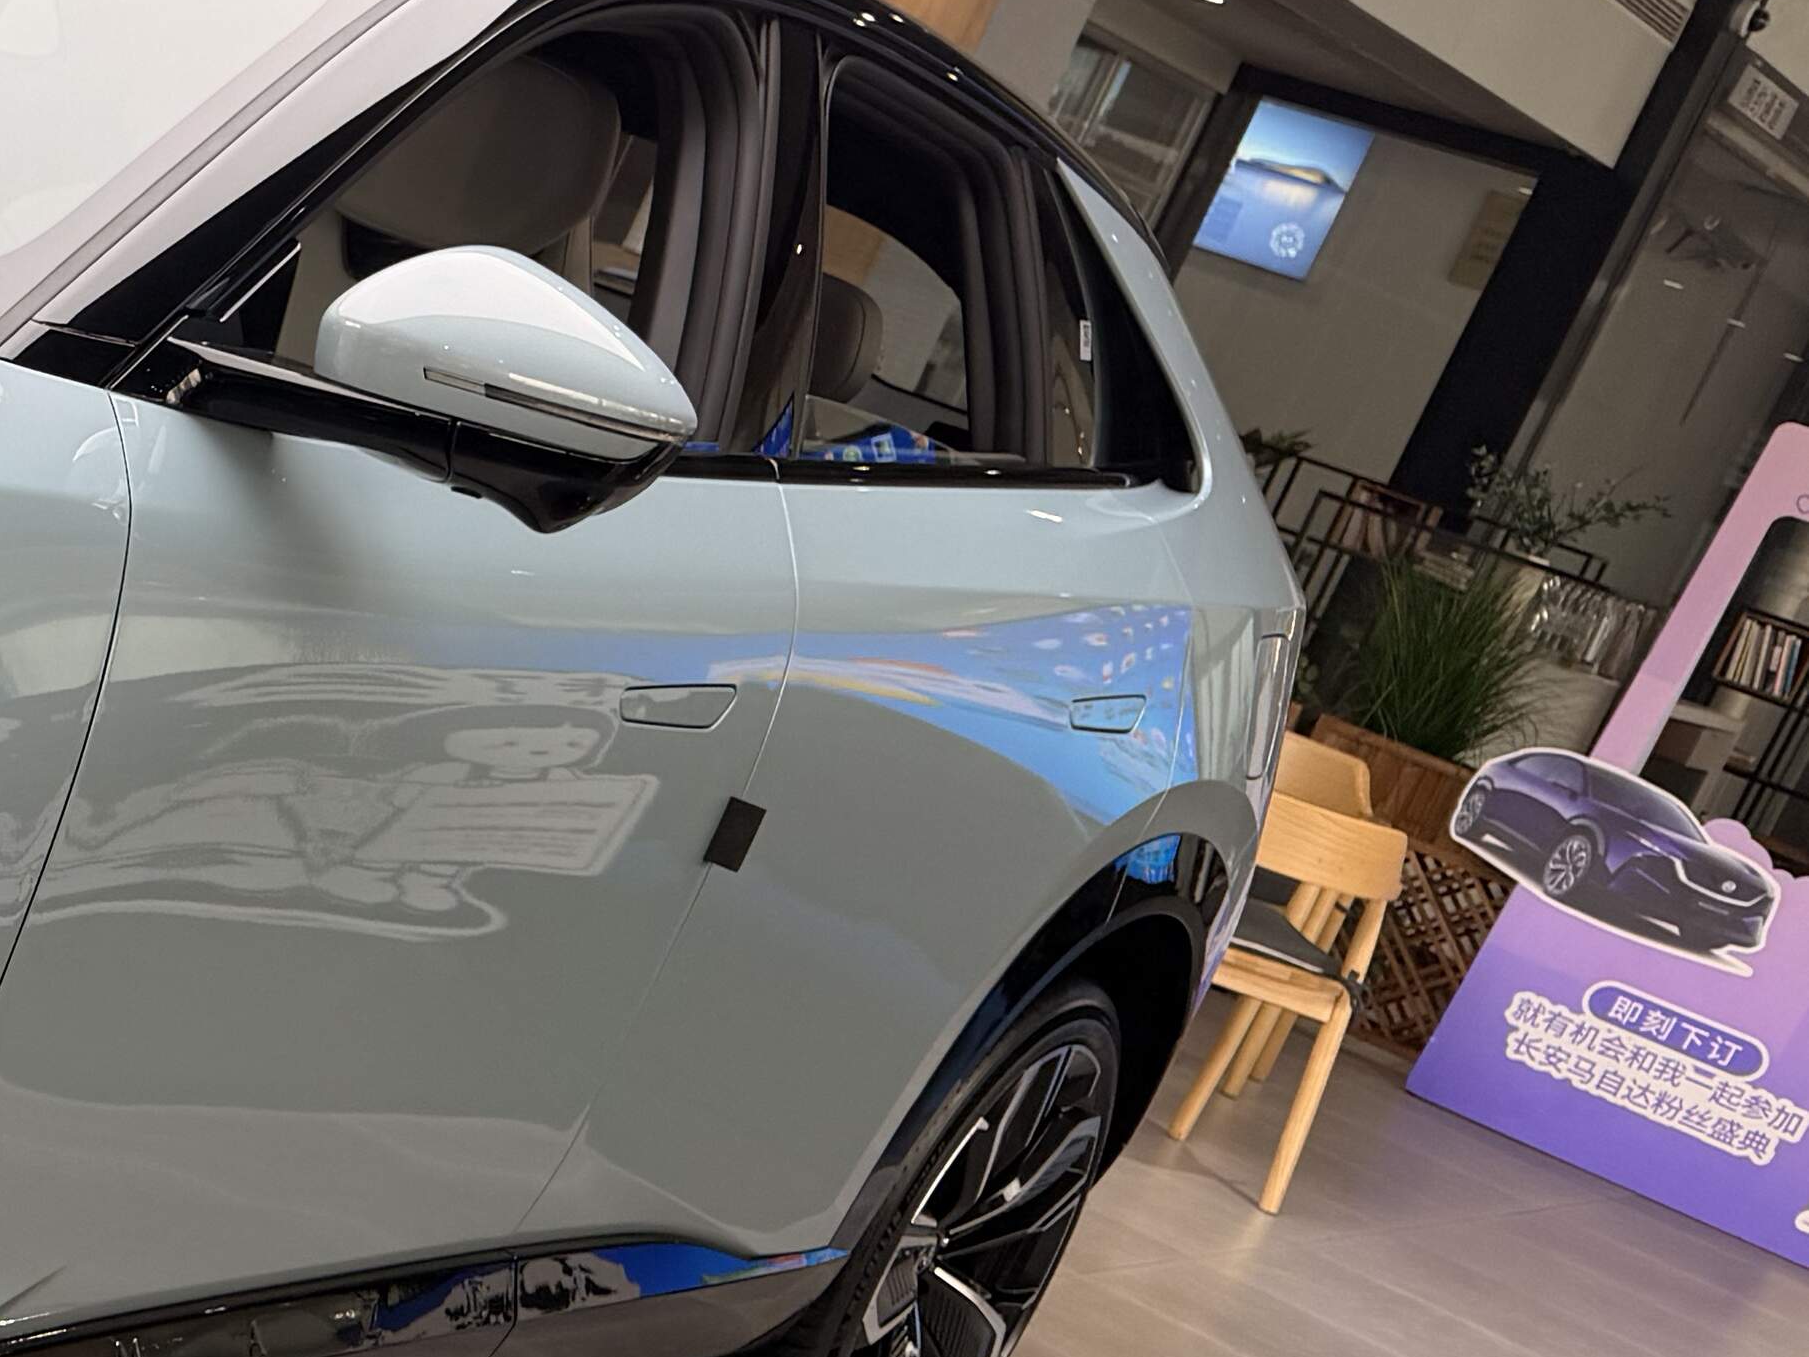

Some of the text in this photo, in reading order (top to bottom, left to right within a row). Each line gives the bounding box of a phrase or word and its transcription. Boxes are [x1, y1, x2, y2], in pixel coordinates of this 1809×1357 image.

[1512, 997, 1804, 1137] 就有机会和我一起参加
[1608, 995, 1743, 1067] 即刻下订
[1512, 1032, 1772, 1160] 长安马自达粉丝盛典
